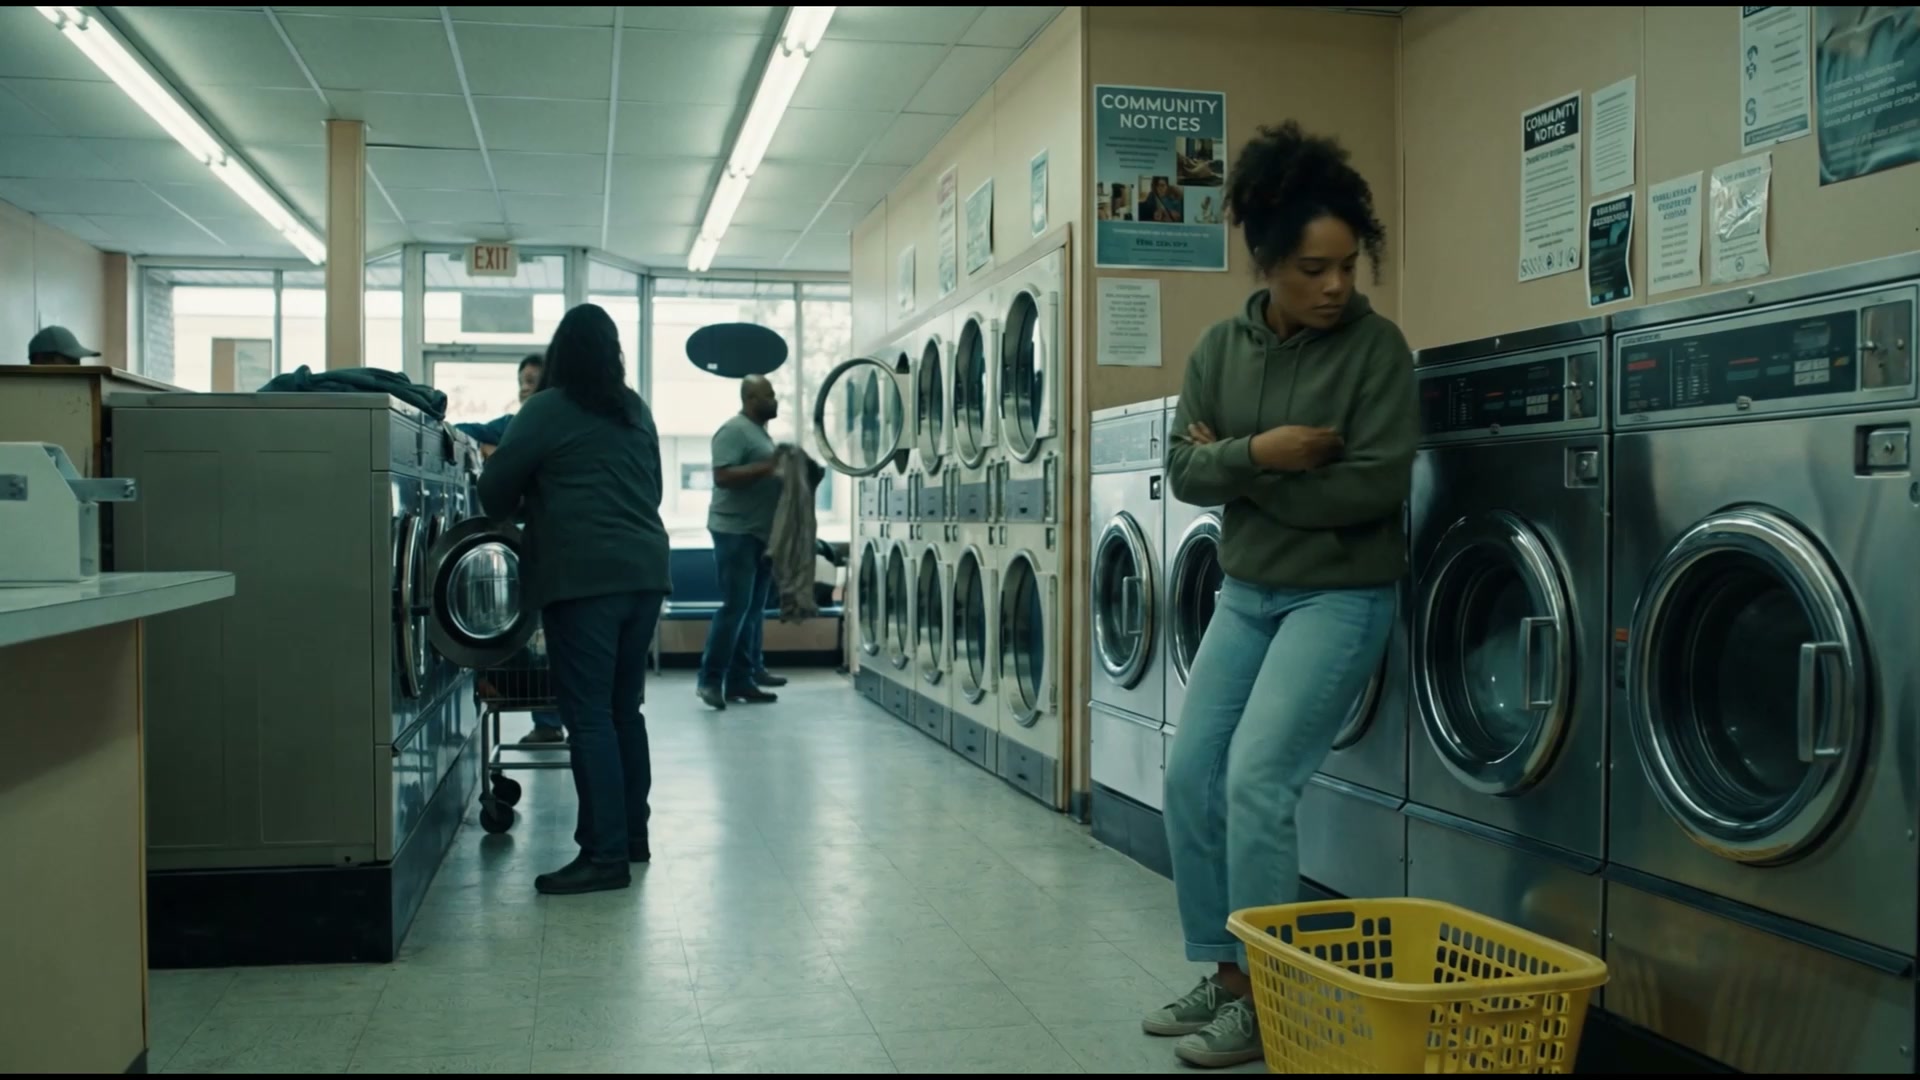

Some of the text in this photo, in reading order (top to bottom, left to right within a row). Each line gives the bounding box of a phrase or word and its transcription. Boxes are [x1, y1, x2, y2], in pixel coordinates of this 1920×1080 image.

[1101, 94, 1217, 115] COMMUNITY
[1120, 113, 1201, 132] NOTICES
[1534, 121, 1567, 144] NOTICE
[474, 246, 509, 270] EXIT
